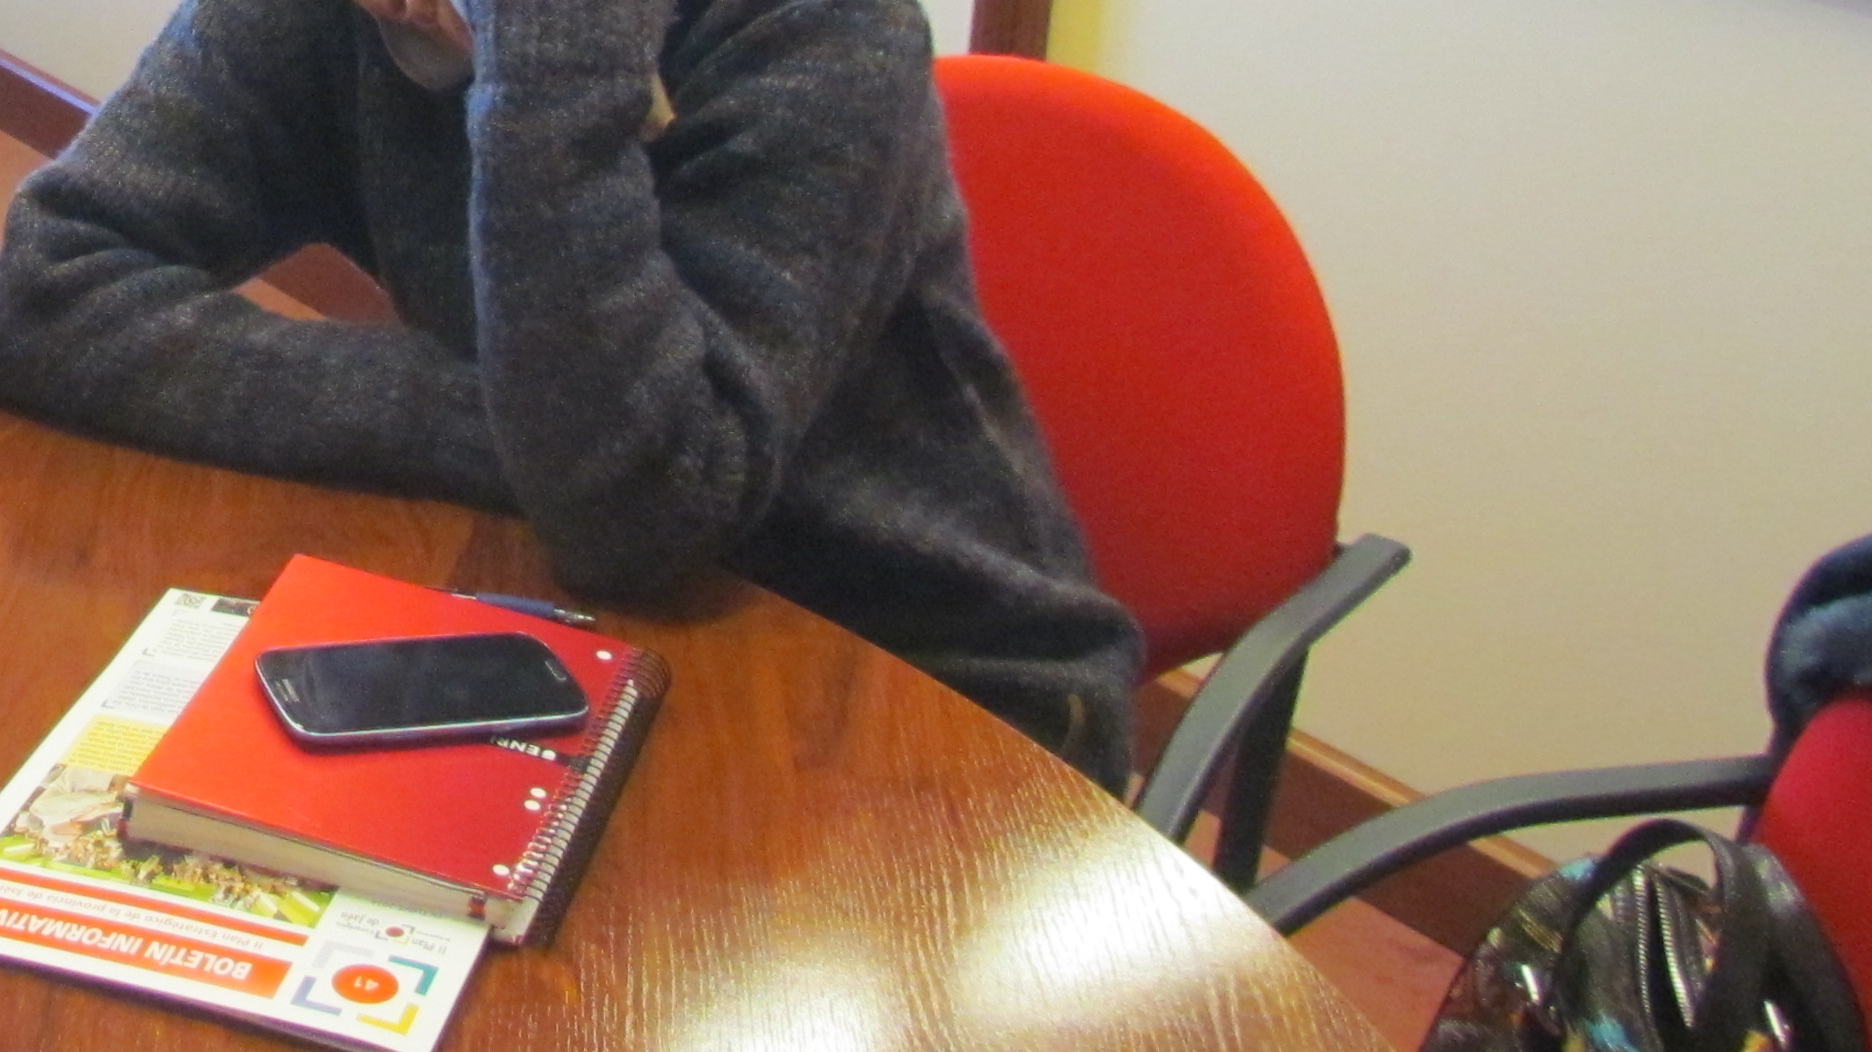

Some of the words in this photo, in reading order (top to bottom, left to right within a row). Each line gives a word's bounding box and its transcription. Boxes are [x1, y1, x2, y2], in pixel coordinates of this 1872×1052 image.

[26, 891, 44, 906] de
[45, 891, 107, 916] provincia
[108, 907, 122, 920] la
[124, 910, 142, 924] de
[221, 932, 252, 948] Plan
[411, 938, 436, 952] Plan
[148, 939, 252, 980] BOLETÍN
[354, 976, 379, 991] 41
